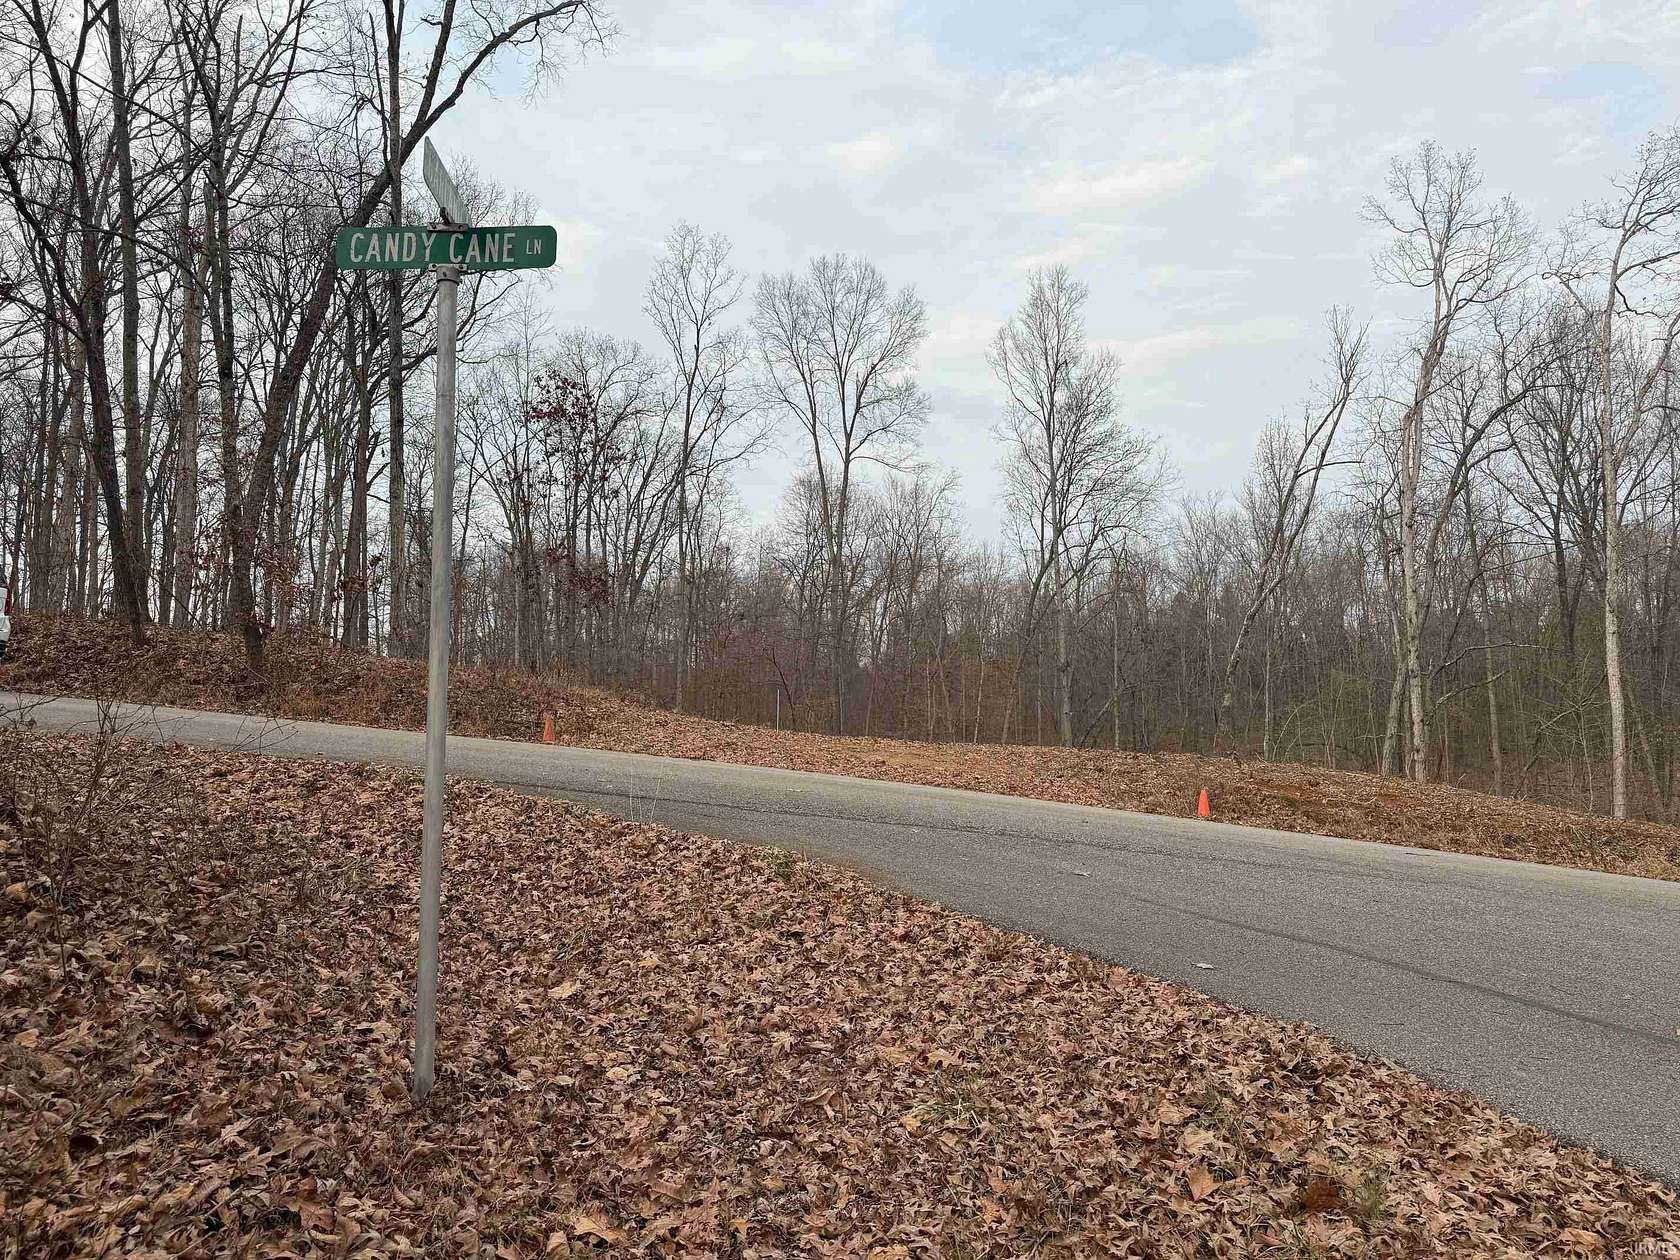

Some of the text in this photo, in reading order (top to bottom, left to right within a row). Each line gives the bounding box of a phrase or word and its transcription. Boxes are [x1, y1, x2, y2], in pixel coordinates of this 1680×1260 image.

[350, 232, 542, 263] CANDY CANE LN
